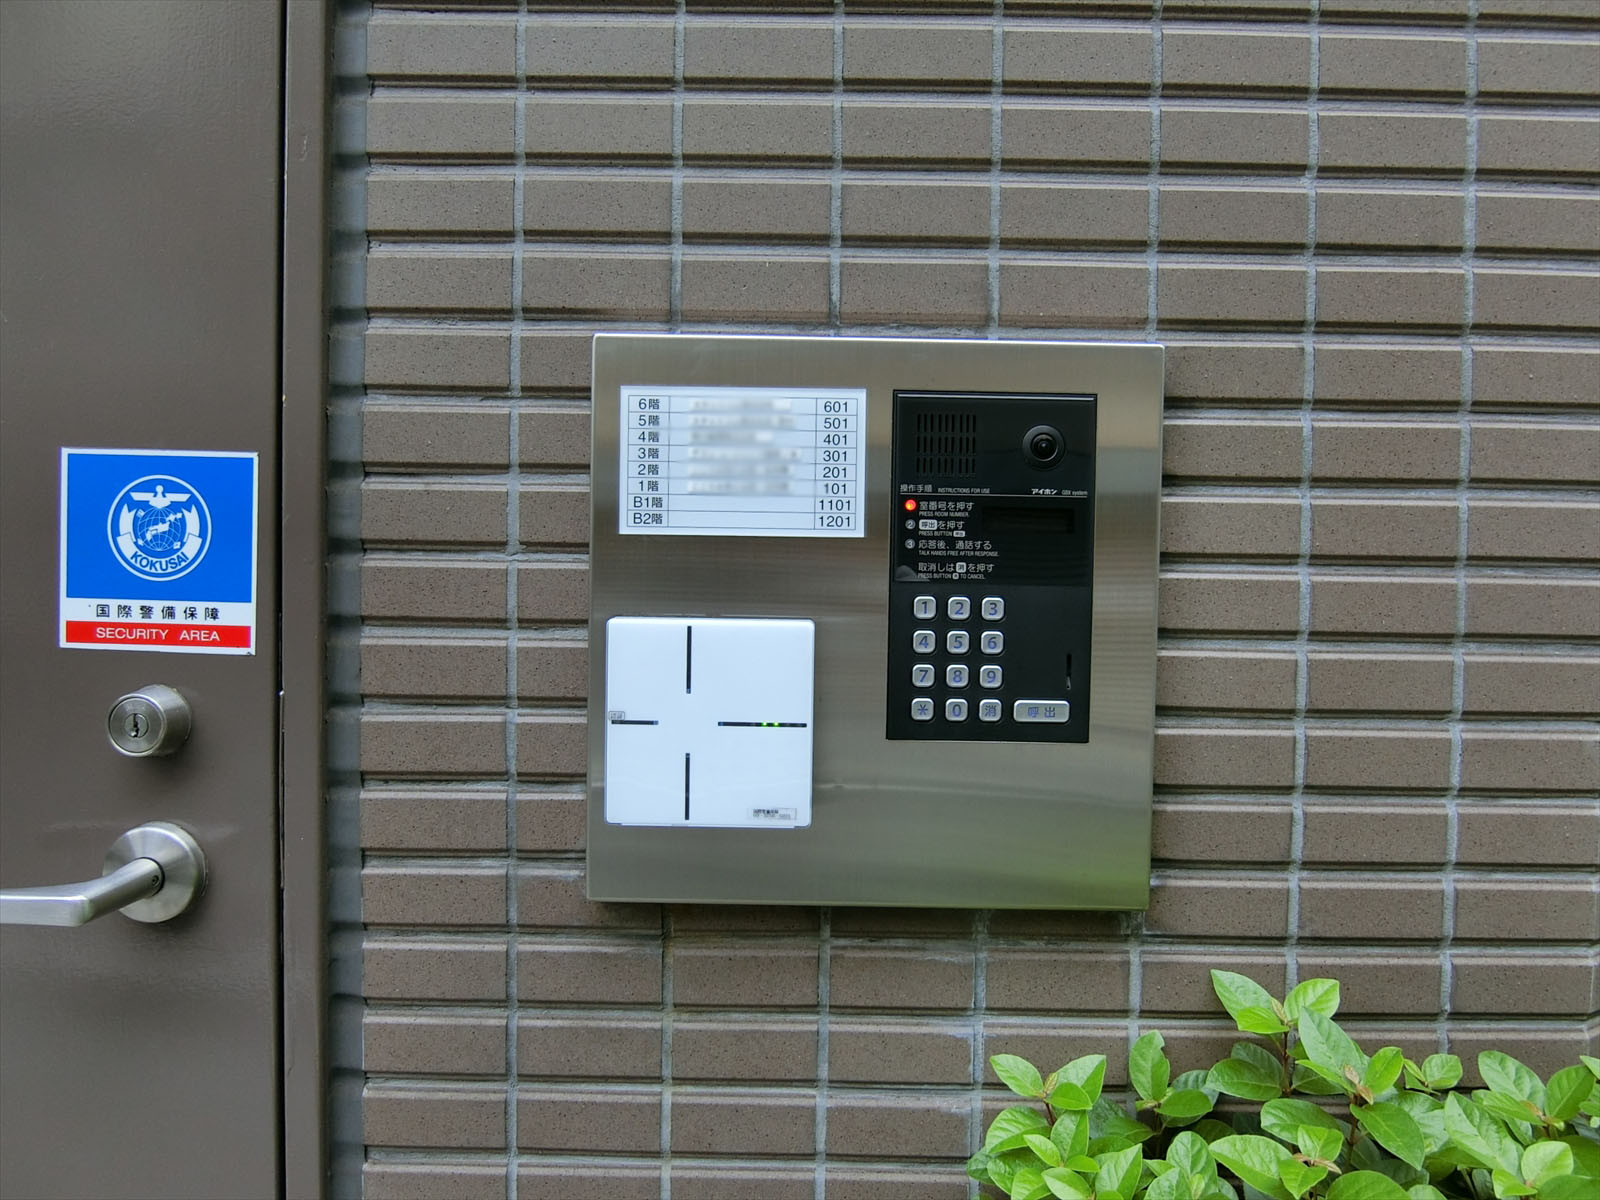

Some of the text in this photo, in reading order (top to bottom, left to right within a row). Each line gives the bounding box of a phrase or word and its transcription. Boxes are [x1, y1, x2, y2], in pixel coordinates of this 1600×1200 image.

[638, 398, 848, 413] 6階 601
[638, 414, 848, 430] 5階 501
[638, 431, 848, 446] 4階 401
[638, 448, 848, 462] 3階 301
[638, 464, 848, 478] 2階 201
[638, 480, 848, 494] 1階 101
[900, 484, 932, 492] 操作手順
[633, 496, 852, 511] B1階 1101
[919, 501, 974, 511] 室番号を押す
[633, 513, 851, 528] B2階 1201
[130, 551, 190, 572] KOKUSAI
[96, 604, 220, 620] 国際警備保障
[922, 602, 998, 616] 1 2 3
[96, 627, 220, 641] SECURITY AREA
[919, 636, 997, 649] 4 5 6
[919, 670, 996, 683] 7 8 9
[952, 704, 961, 717] 0
[984, 705, 997, 717] 消
[1028, 706, 1056, 718] 呼出
